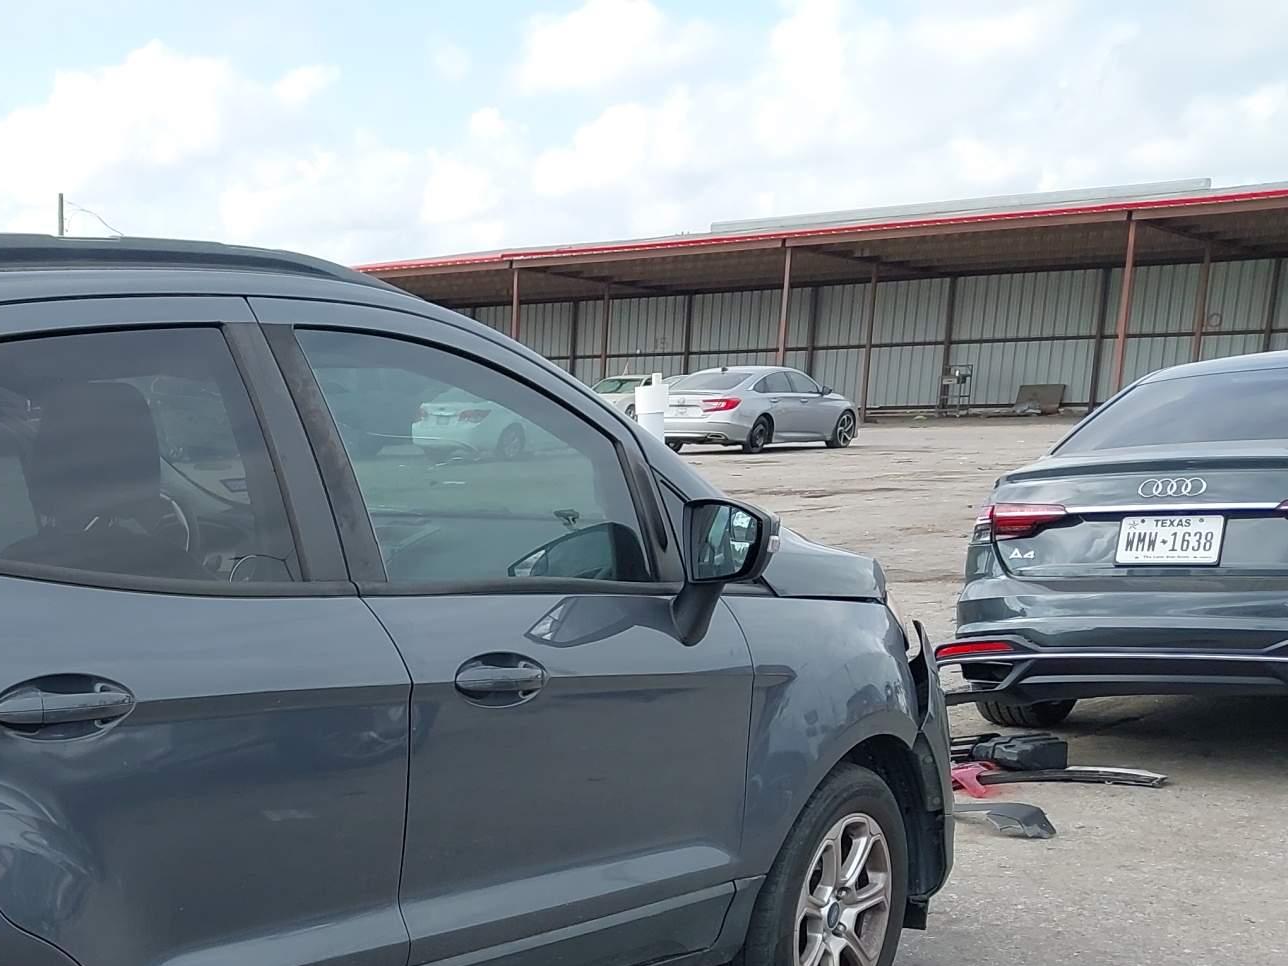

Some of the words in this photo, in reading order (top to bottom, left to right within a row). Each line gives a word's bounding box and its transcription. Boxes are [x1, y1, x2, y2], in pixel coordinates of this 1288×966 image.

[1153, 518, 1192, 527] TEXAS
[1124, 531, 1159, 552] WMW
[1168, 531, 1214, 552] 1638
[1009, 547, 1035, 560] A4
